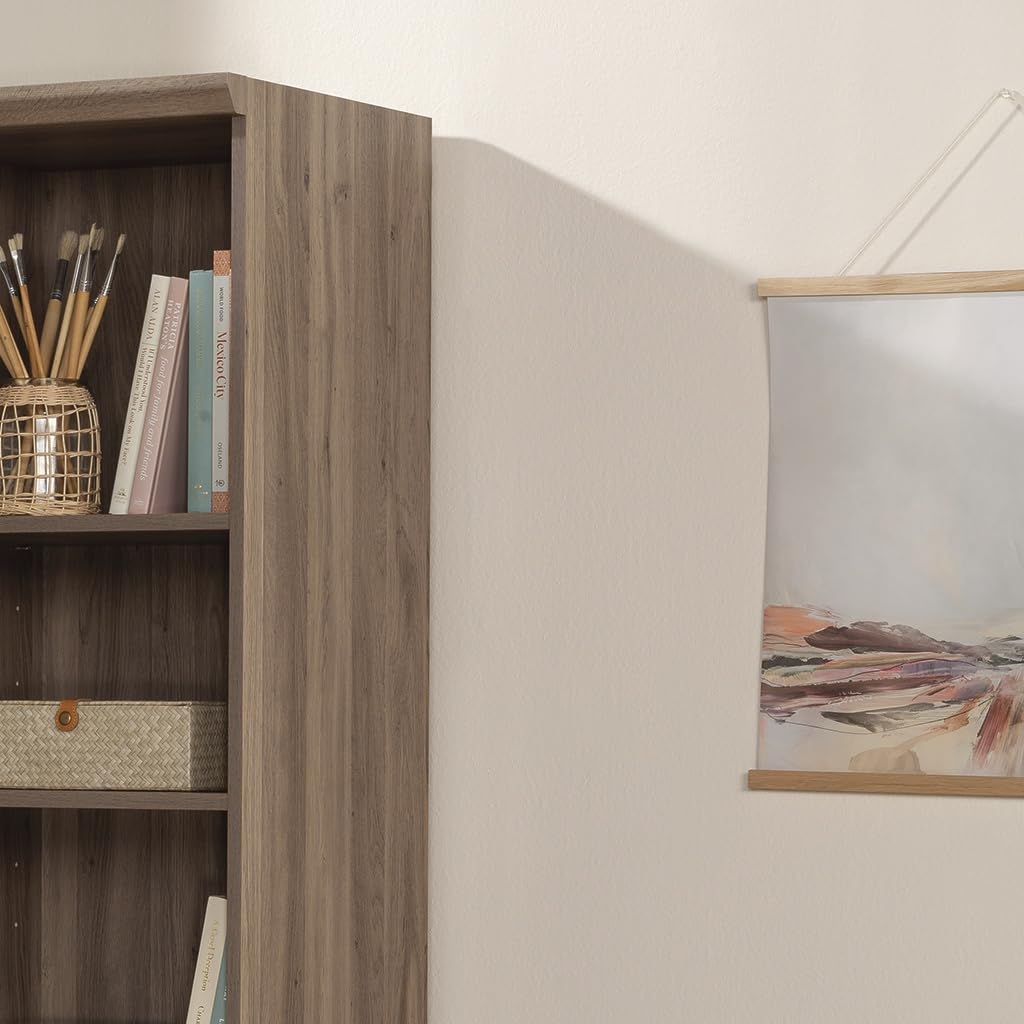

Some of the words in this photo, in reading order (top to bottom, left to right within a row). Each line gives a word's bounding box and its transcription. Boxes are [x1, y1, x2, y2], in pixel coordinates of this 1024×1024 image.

[152, 289, 161, 313] ALAN
[146, 317, 156, 340] ALDA
[167, 302, 182, 350] PATRICIA
[139, 347, 147, 368] Would
[216, 332, 227, 374] Mexico
[141, 360, 154, 398] Understood
[158, 356, 169, 379] food
[154, 379, 164, 394] for
[214, 375, 227, 398] City
[148, 394, 161, 426] family
[146, 428, 154, 447] and
[139, 447, 152, 481] friends
